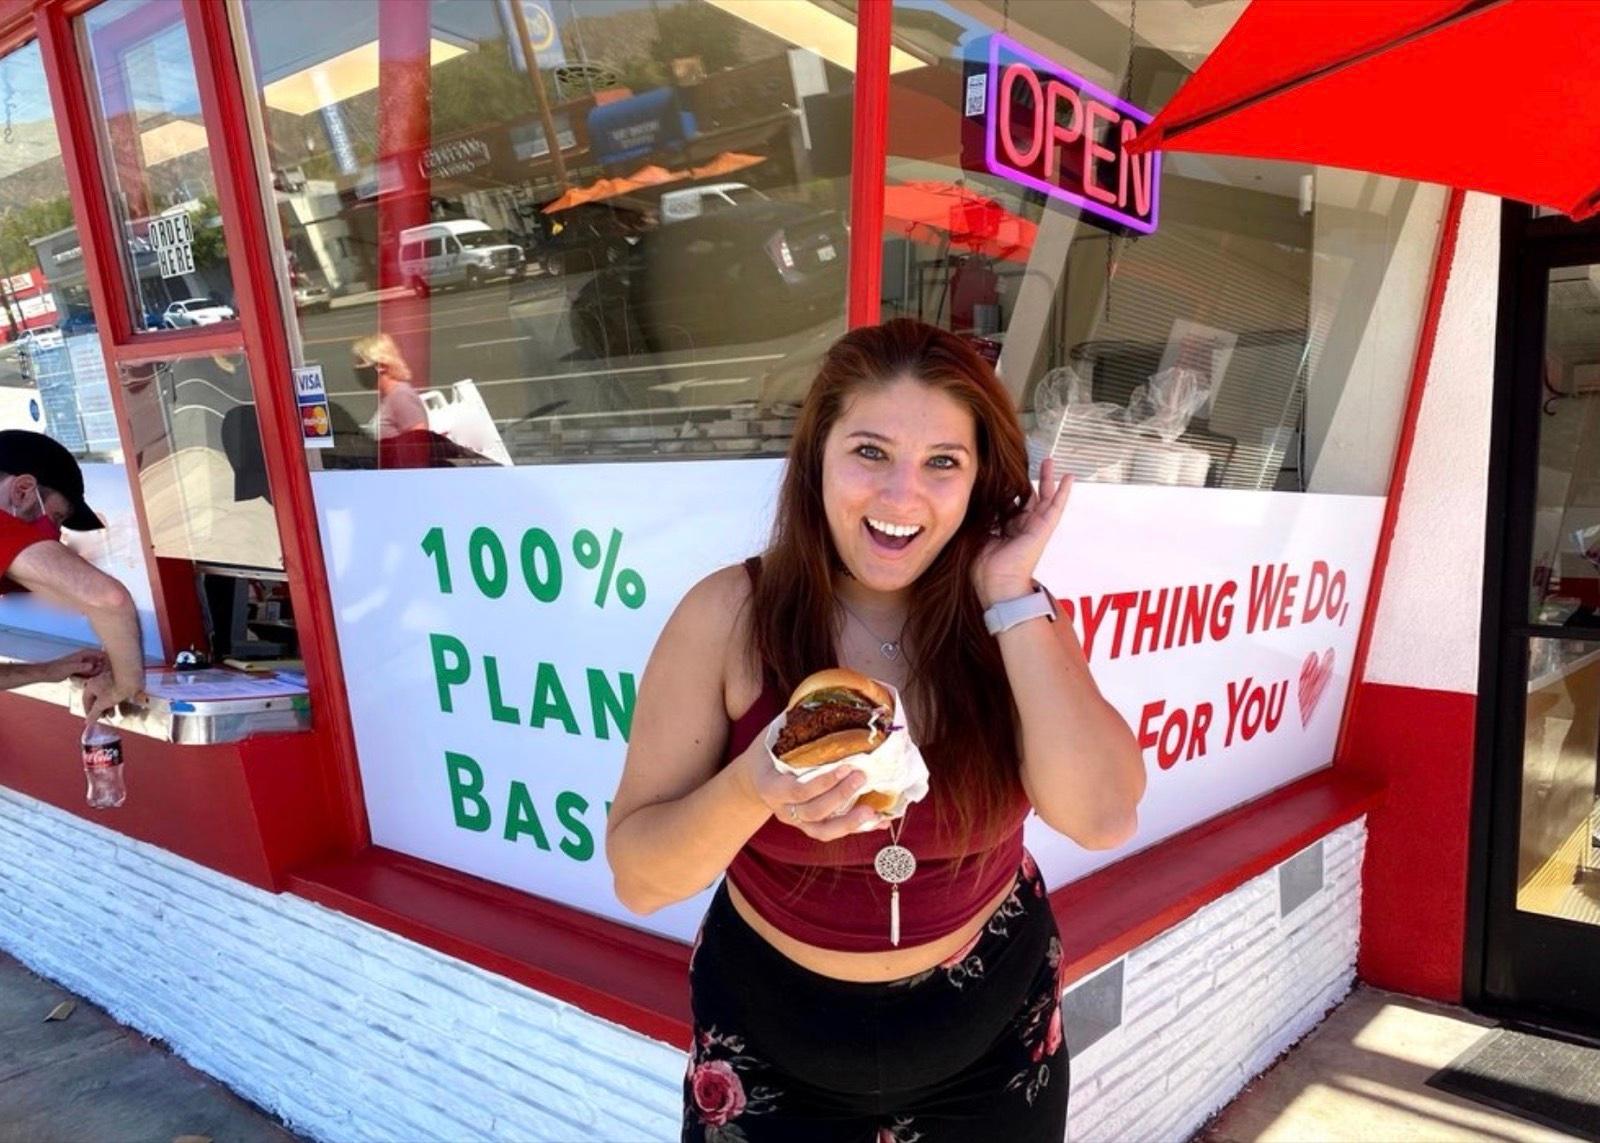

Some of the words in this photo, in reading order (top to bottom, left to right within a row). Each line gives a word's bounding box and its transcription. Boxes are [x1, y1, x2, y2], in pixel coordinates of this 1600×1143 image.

[1000, 63, 1151, 216] OPEN
[150, 214, 193, 249] ORDER
[159, 245, 193, 276] HERE
[299, 373, 322, 390] VISA
[421, 527, 646, 609] 100%
[1246, 563, 1300, 634] WE
[1301, 560, 1349, 627] DO,
[1136, 699, 1214, 771] FOR
[1223, 677, 1289, 748] YOU
[445, 750, 613, 862] BAS
